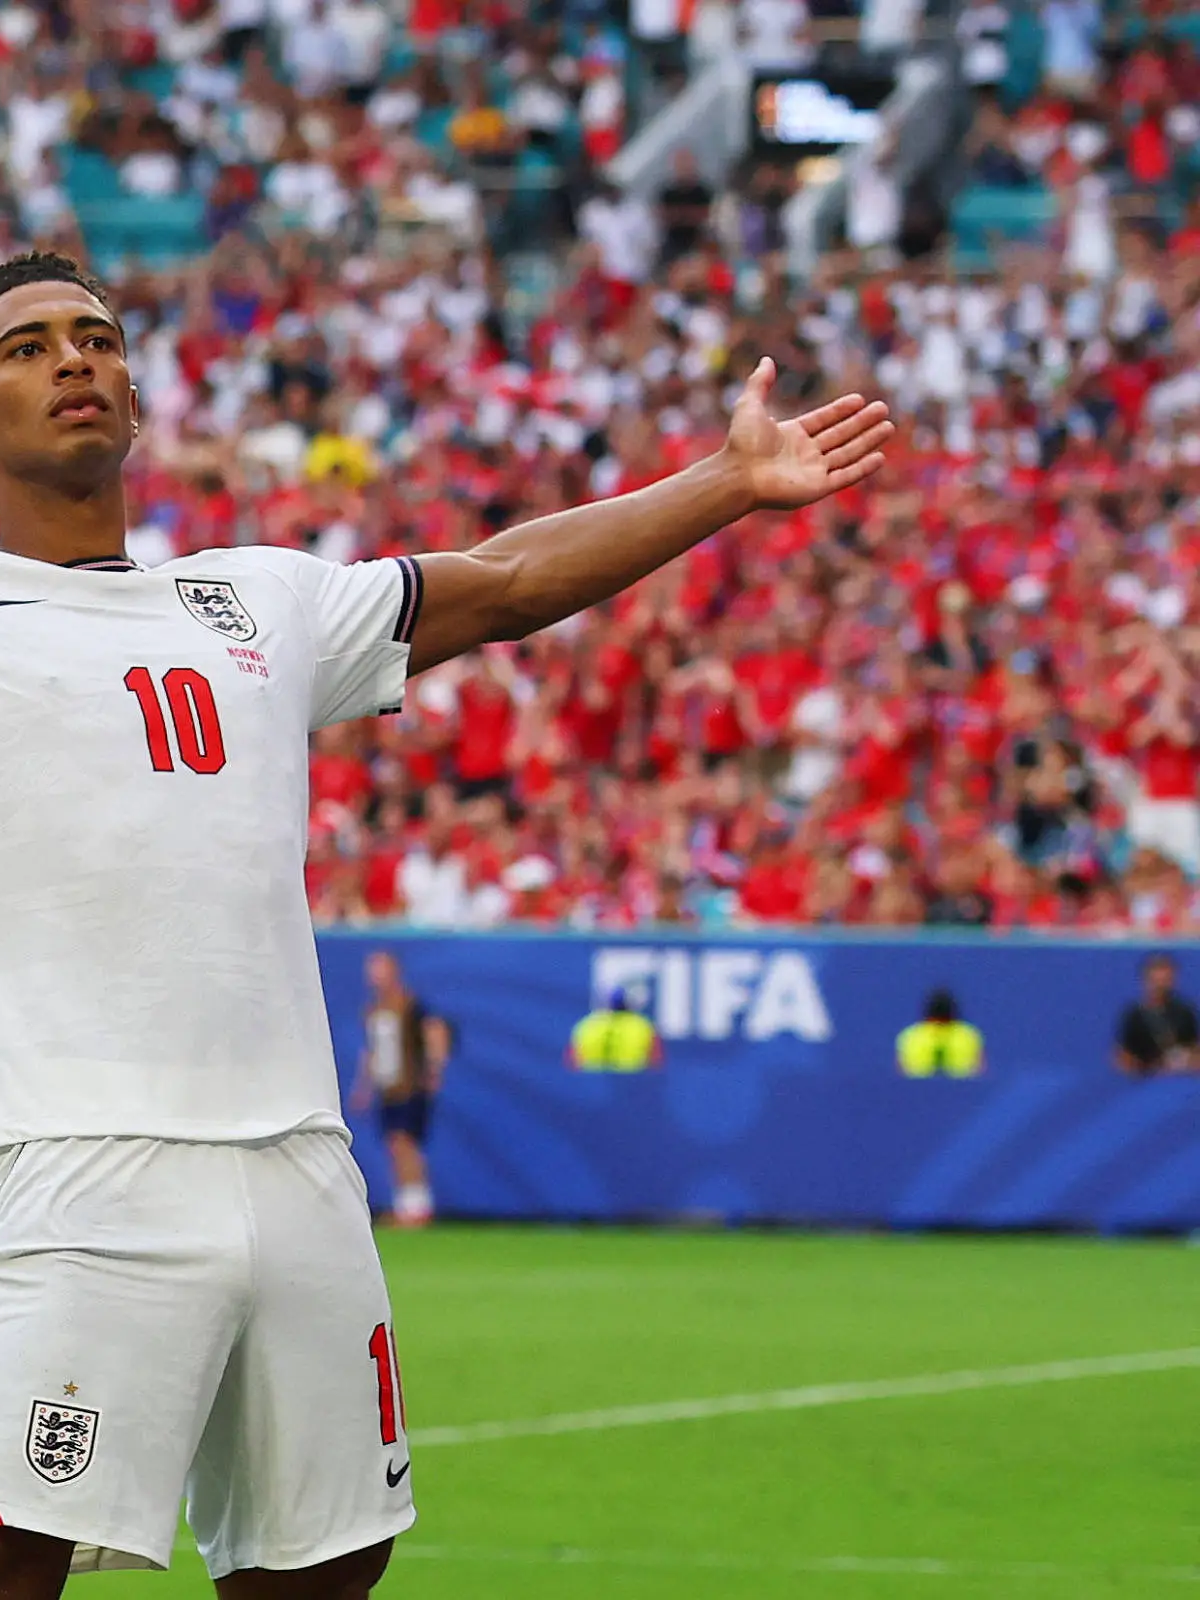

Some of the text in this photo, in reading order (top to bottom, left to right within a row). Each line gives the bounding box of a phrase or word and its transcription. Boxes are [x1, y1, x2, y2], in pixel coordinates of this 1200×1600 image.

[226, 647, 266, 662] NORWAY
[123, 666, 227, 775] 10
[592, 948, 834, 1041] FIFA
[368, 1322, 406, 1446] 1
